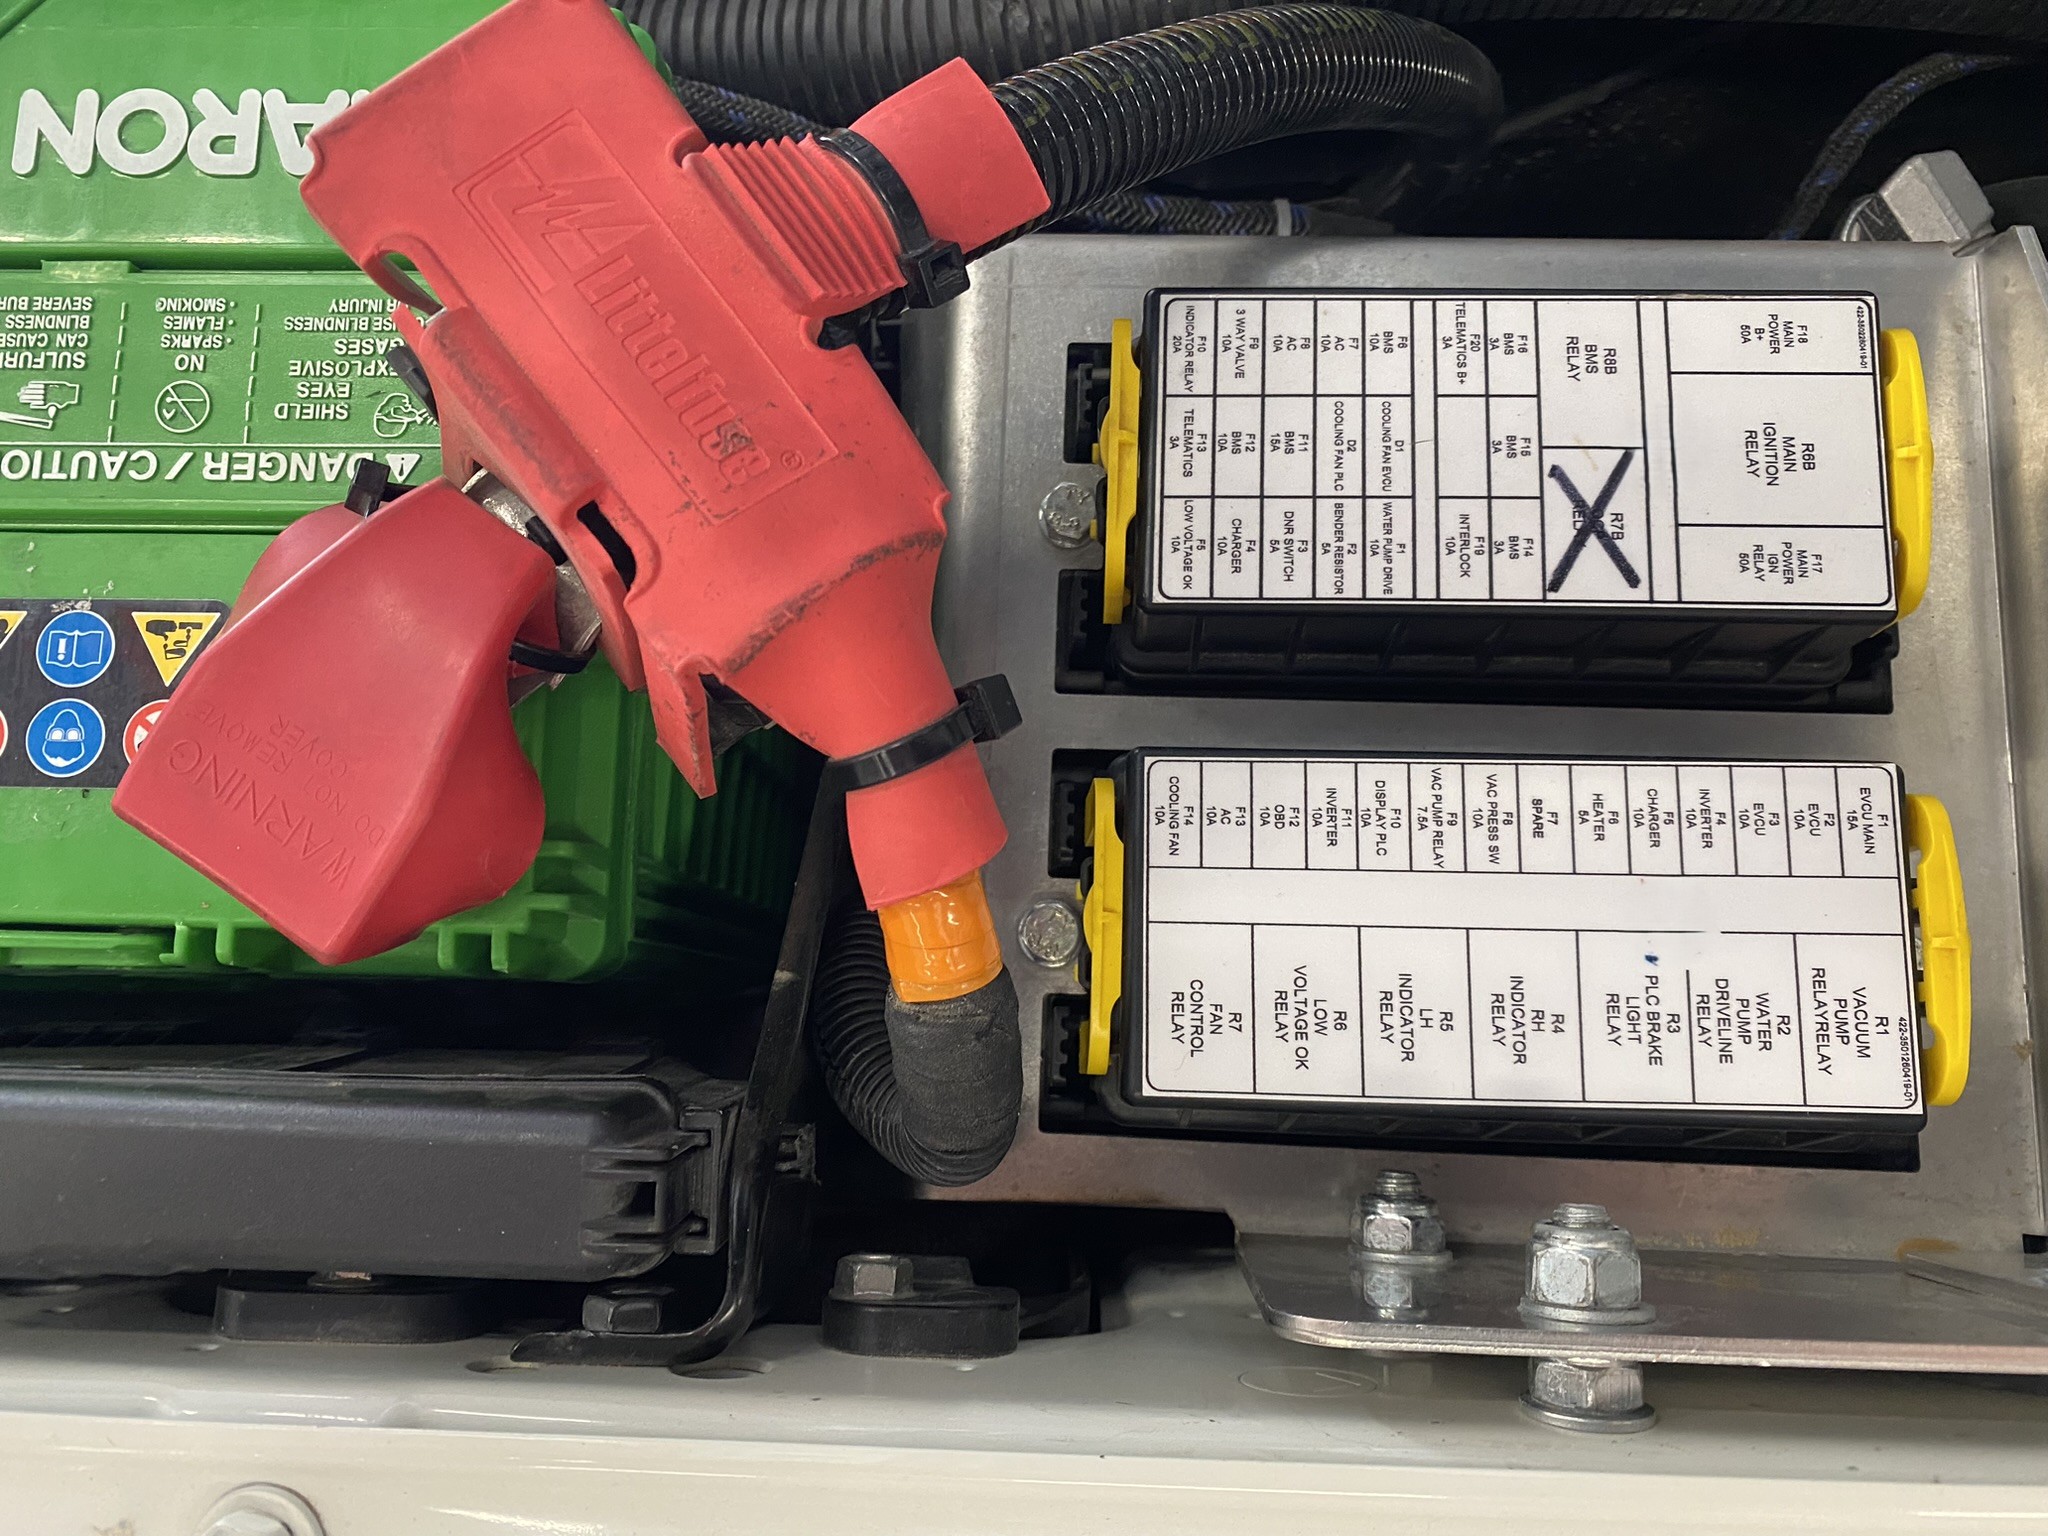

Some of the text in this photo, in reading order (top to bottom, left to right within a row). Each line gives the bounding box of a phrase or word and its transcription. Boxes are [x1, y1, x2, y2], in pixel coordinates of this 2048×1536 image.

[11, 88, 367, 176] ARON
[32, 296, 93, 311] SEVERE
[156, 297, 226, 311] SMOKING
[328, 298, 383, 313] INJURY
[5, 314, 91, 330] BLINDNESS
[163, 316, 224, 330] FLAMES
[284, 316, 369, 331] BLINDNESS
[1740, 324, 1752, 344] 50A
[1754, 327, 1765, 341] B+
[1768, 314, 1781, 355] POWER
[1782, 320, 1795, 348] MAIN
[1797, 325, 1809, 344] F18
[55, 332, 89, 348] CAN
[160, 334, 223, 348] SPARKS
[1172, 335, 1183, 354] 20A
[1184, 305, 1195, 393] INDICATOR RELAY
[1197, 336, 1207, 353] F10
[1234, 308, 1247, 379] 3 WAY VALVE
[1334, 336, 1345, 351] AC
[1349, 337, 1359, 350] F7
[1442, 336, 1453, 350] 3A
[1455, 302, 1467, 385] TELEMATICS B+
[1470, 334, 1481, 352] F20
[174, 354, 205, 371] NO
[289, 360, 400, 377] XPLOSIVE
[574, 254, 770, 486] Littelfuse
[1566, 336, 1581, 382] RELAY
[1584, 344, 1599, 374] BMS
[1603, 348, 1618, 375] R8B
[297, 381, 350, 398] EYES
[274, 403, 349, 420] SHIELD
[1182, 408, 1195, 478] TELEMATICS
[1270, 433, 1281, 453] 15A
[1298, 434, 1309, 452] F11
[1334, 400, 1344, 492] COOLING FAN PLC
[1346, 439, 1357, 452] D2
[1381, 401, 1392, 492] COOLING FAN EVCU
[1394, 440, 1405, 452] D1
[1744, 430, 1760, 478] RELAY
[1762, 422, 1780, 486] IGNITION
[1782, 436, 1797, 472] MAIN
[1801, 443, 1816, 471] R6B
[0, 449, 158, 481] CAUTIO
[164, 451, 194, 480] /
[1610, 512, 1624, 541] R7B
[1182, 499, 1194, 590] LOW VOLTAGE OK
[1196, 538, 1206, 551] F5
[1231, 518, 1242, 574] CHARGER
[1283, 511, 1295, 582] DNR SWITCH
[1321, 542, 1331, 556] 5A
[1334, 502, 1344, 595] BENDER RESISTOR
[1382, 501, 1393, 595] WATER PUMP DRIVE
[1396, 543, 1406, 554] F1
[1445, 536, 1456, 556] 10A
[1459, 513, 1471, 578] INTERLOCK
[1474, 536, 1485, 556] F19
[1523, 538, 1534, 557] F14
[1738, 552, 1750, 574] 50A
[1752, 544, 1766, 582] RELAY
[1767, 553, 1779, 574] IGN
[1781, 541, 1794, 585] POWER
[1796, 549, 1809, 578] MAIN
[1811, 554, 1823, 574] F17
[269, 714, 347, 779] COVER
[169, 738, 356, 892] WARNING
[1154, 805, 1166, 826] 10A
[1168, 776, 1180, 856] COOLING FAN
[1183, 806, 1194, 826] F14
[1274, 804, 1286, 830] OBD
[1326, 787, 1338, 847] INVERTER
[1374, 780, 1387, 856] DISPLAY PLC
[1417, 806, 1429, 831] 7.5A
[1431, 767, 1445, 869] VAC PUMP RELAY
[1486, 773, 1500, 865] VAC PRESS SW
[1531, 798, 1544, 839] SPARE
[1547, 811, 1559, 825] F7
[1592, 793, 1605, 842] HEATER
[1608, 811, 1619, 825] F6
[1647, 788, 1661, 848] CHARGER
[1699, 788, 1713, 849] INVERTER
[1808, 803, 1821, 837] EVCU
[1846, 809, 1859, 831] 15A
[1859, 787, 1876, 854] EVCU MAIN
[1171, 991, 1185, 1044] RELAY
[1190, 979, 1204, 1058] CONTROL
[1209, 1003, 1223, 1035] FAN
[1228, 1012, 1242, 1033] R7
[1274, 990, 1289, 1043] RELAY
[1293, 965, 1309, 1070] VOLTAGE OK
[1313, 999, 1328, 1036] LOW
[1333, 1010, 1348, 1031] R6
[1379, 990, 1395, 1044] RELAY
[1398, 973, 1415, 1062] INDICATOR
[1419, 1008, 1434, 1028] LH
[1439, 1011, 1454, 1032] R5
[1490, 993, 1506, 1047] RELAY
[1509, 976, 1527, 1065] INDICATOR
[1530, 1009, 1545, 1032] RH
[1551, 1013, 1565, 1034] R4
[1605, 993, 1622, 1046] RELAY
[1625, 996, 1642, 1044] LIGHT
[1645, 975, 1663, 1066] PLC BRAKE
[1666, 1013, 1681, 1034] R3
[1696, 994, 1713, 1047] RELAY
[1715, 978, 1733, 1064] DRIVELINE
[1735, 998, 1752, 1045] PUMP
[1755, 992, 1772, 1052] WATER
[1776, 1015, 1791, 1036] R2
[1811, 967, 1833, 1076] RELAYRELAY
[1833, 998, 1850, 1046] PUMP
[1852, 986, 1871, 1058] VACUUM
[1874, 1016, 1890, 1035] R1
